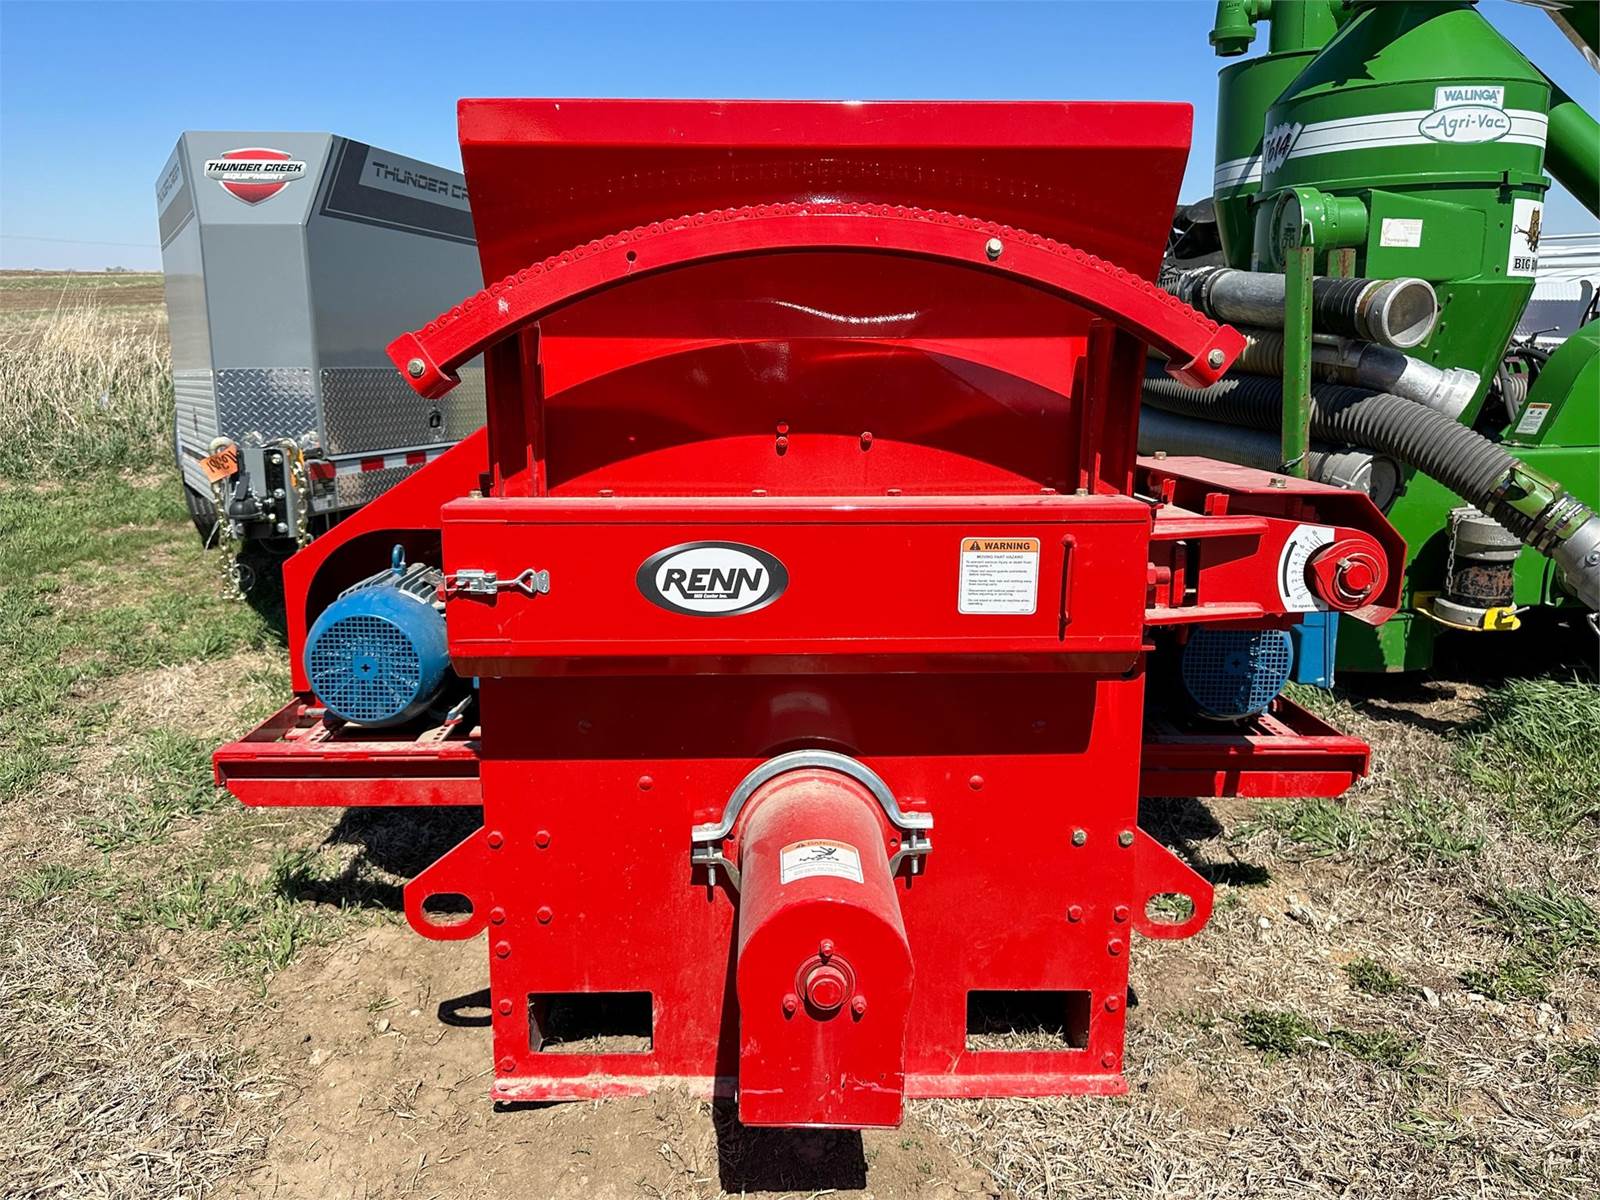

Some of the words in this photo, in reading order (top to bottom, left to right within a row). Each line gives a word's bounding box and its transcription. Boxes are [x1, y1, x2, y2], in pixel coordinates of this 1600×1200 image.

[1444, 89, 1498, 101] WALINGA
[1425, 114, 1506, 138] Agri-Vac
[207, 163, 263, 172] THUNDER
[263, 163, 303, 172] CREEK
[372, 161, 449, 196] THUNDER
[1513, 257, 1531, 271] BIG
[984, 542, 1030, 550] WARNING
[662, 568, 763, 598] RENN
